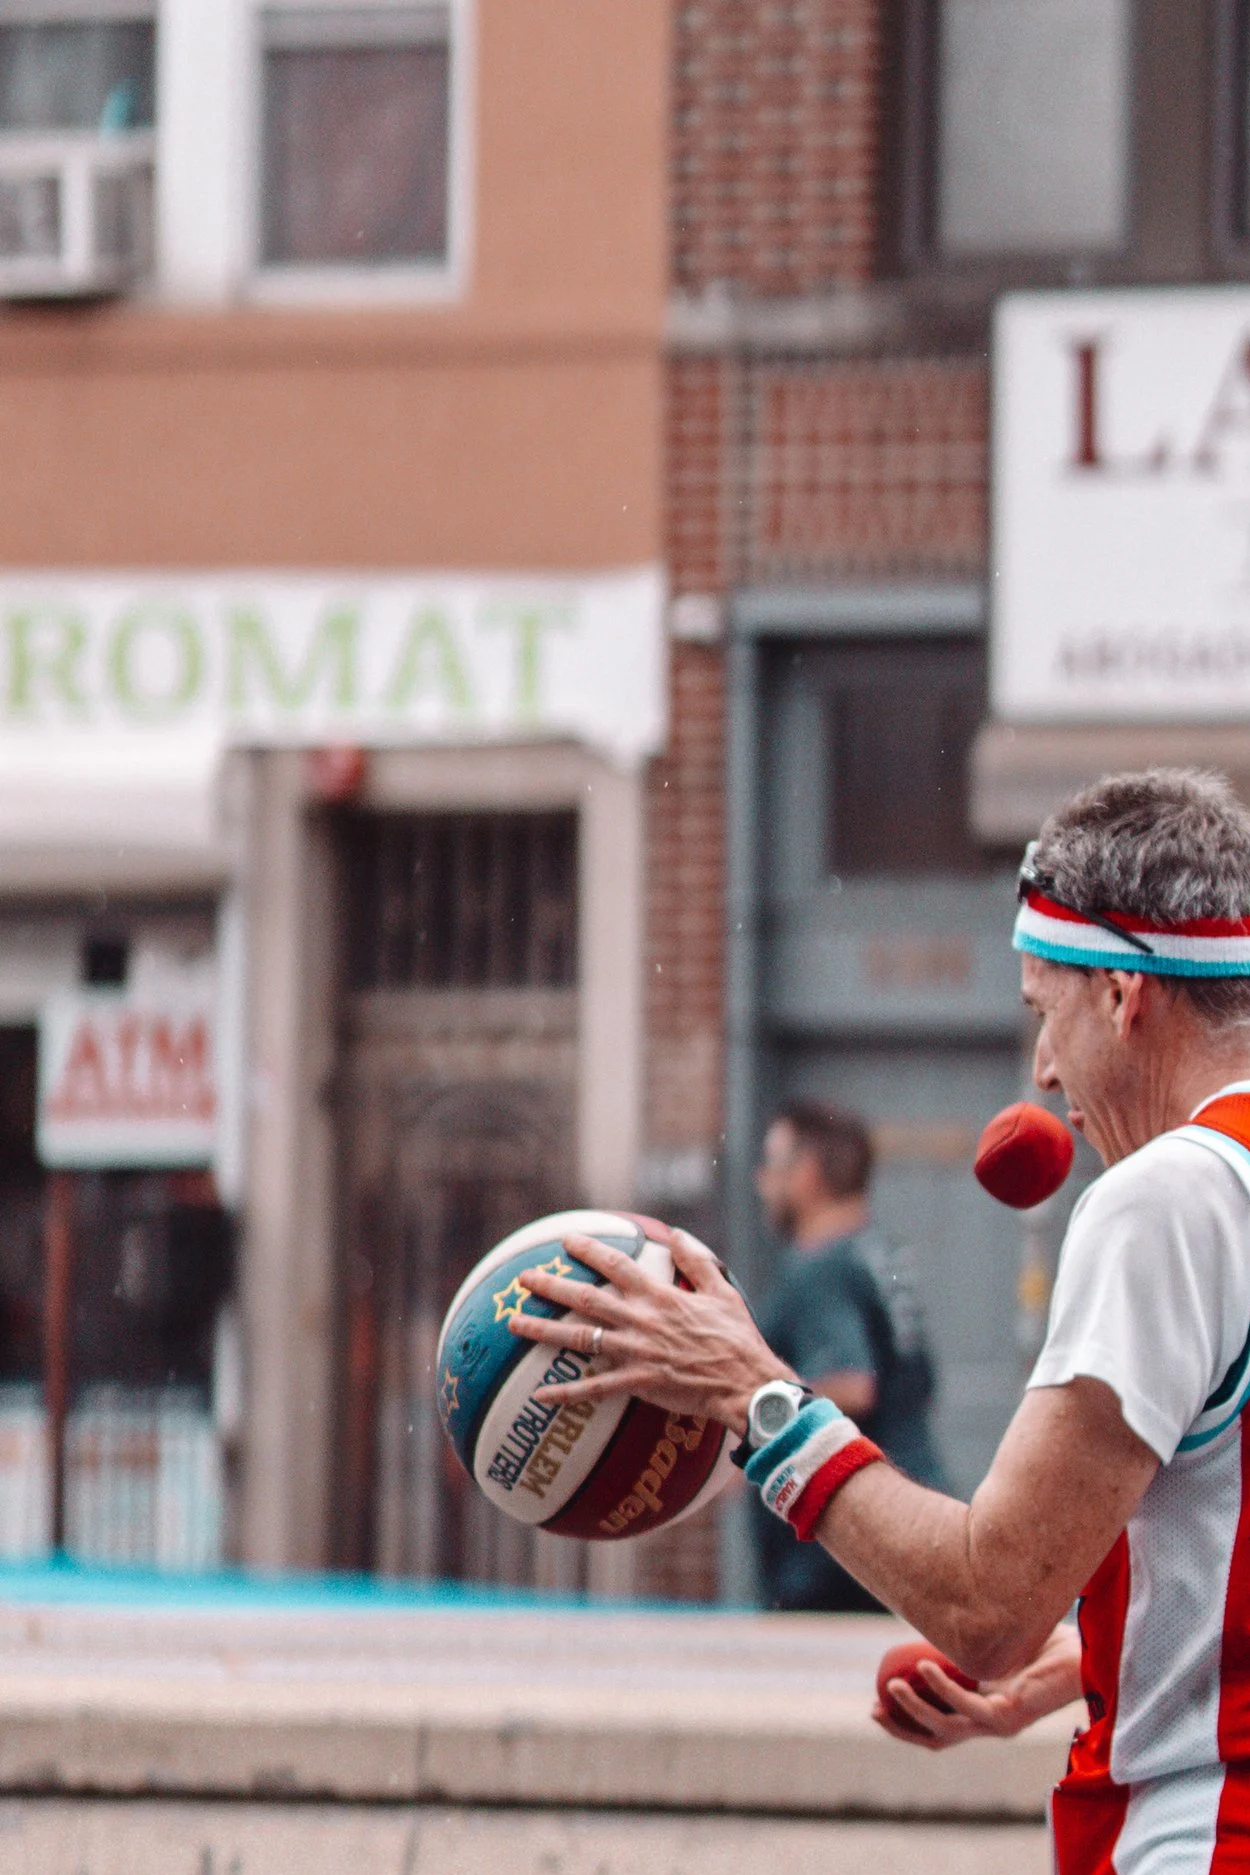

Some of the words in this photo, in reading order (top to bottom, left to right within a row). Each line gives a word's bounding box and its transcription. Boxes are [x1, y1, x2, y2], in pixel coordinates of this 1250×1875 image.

[4, 602, 580, 724] ROMAT
[48, 1010, 216, 1122] ATM
[518, 1366, 600, 1500] ARLEM
